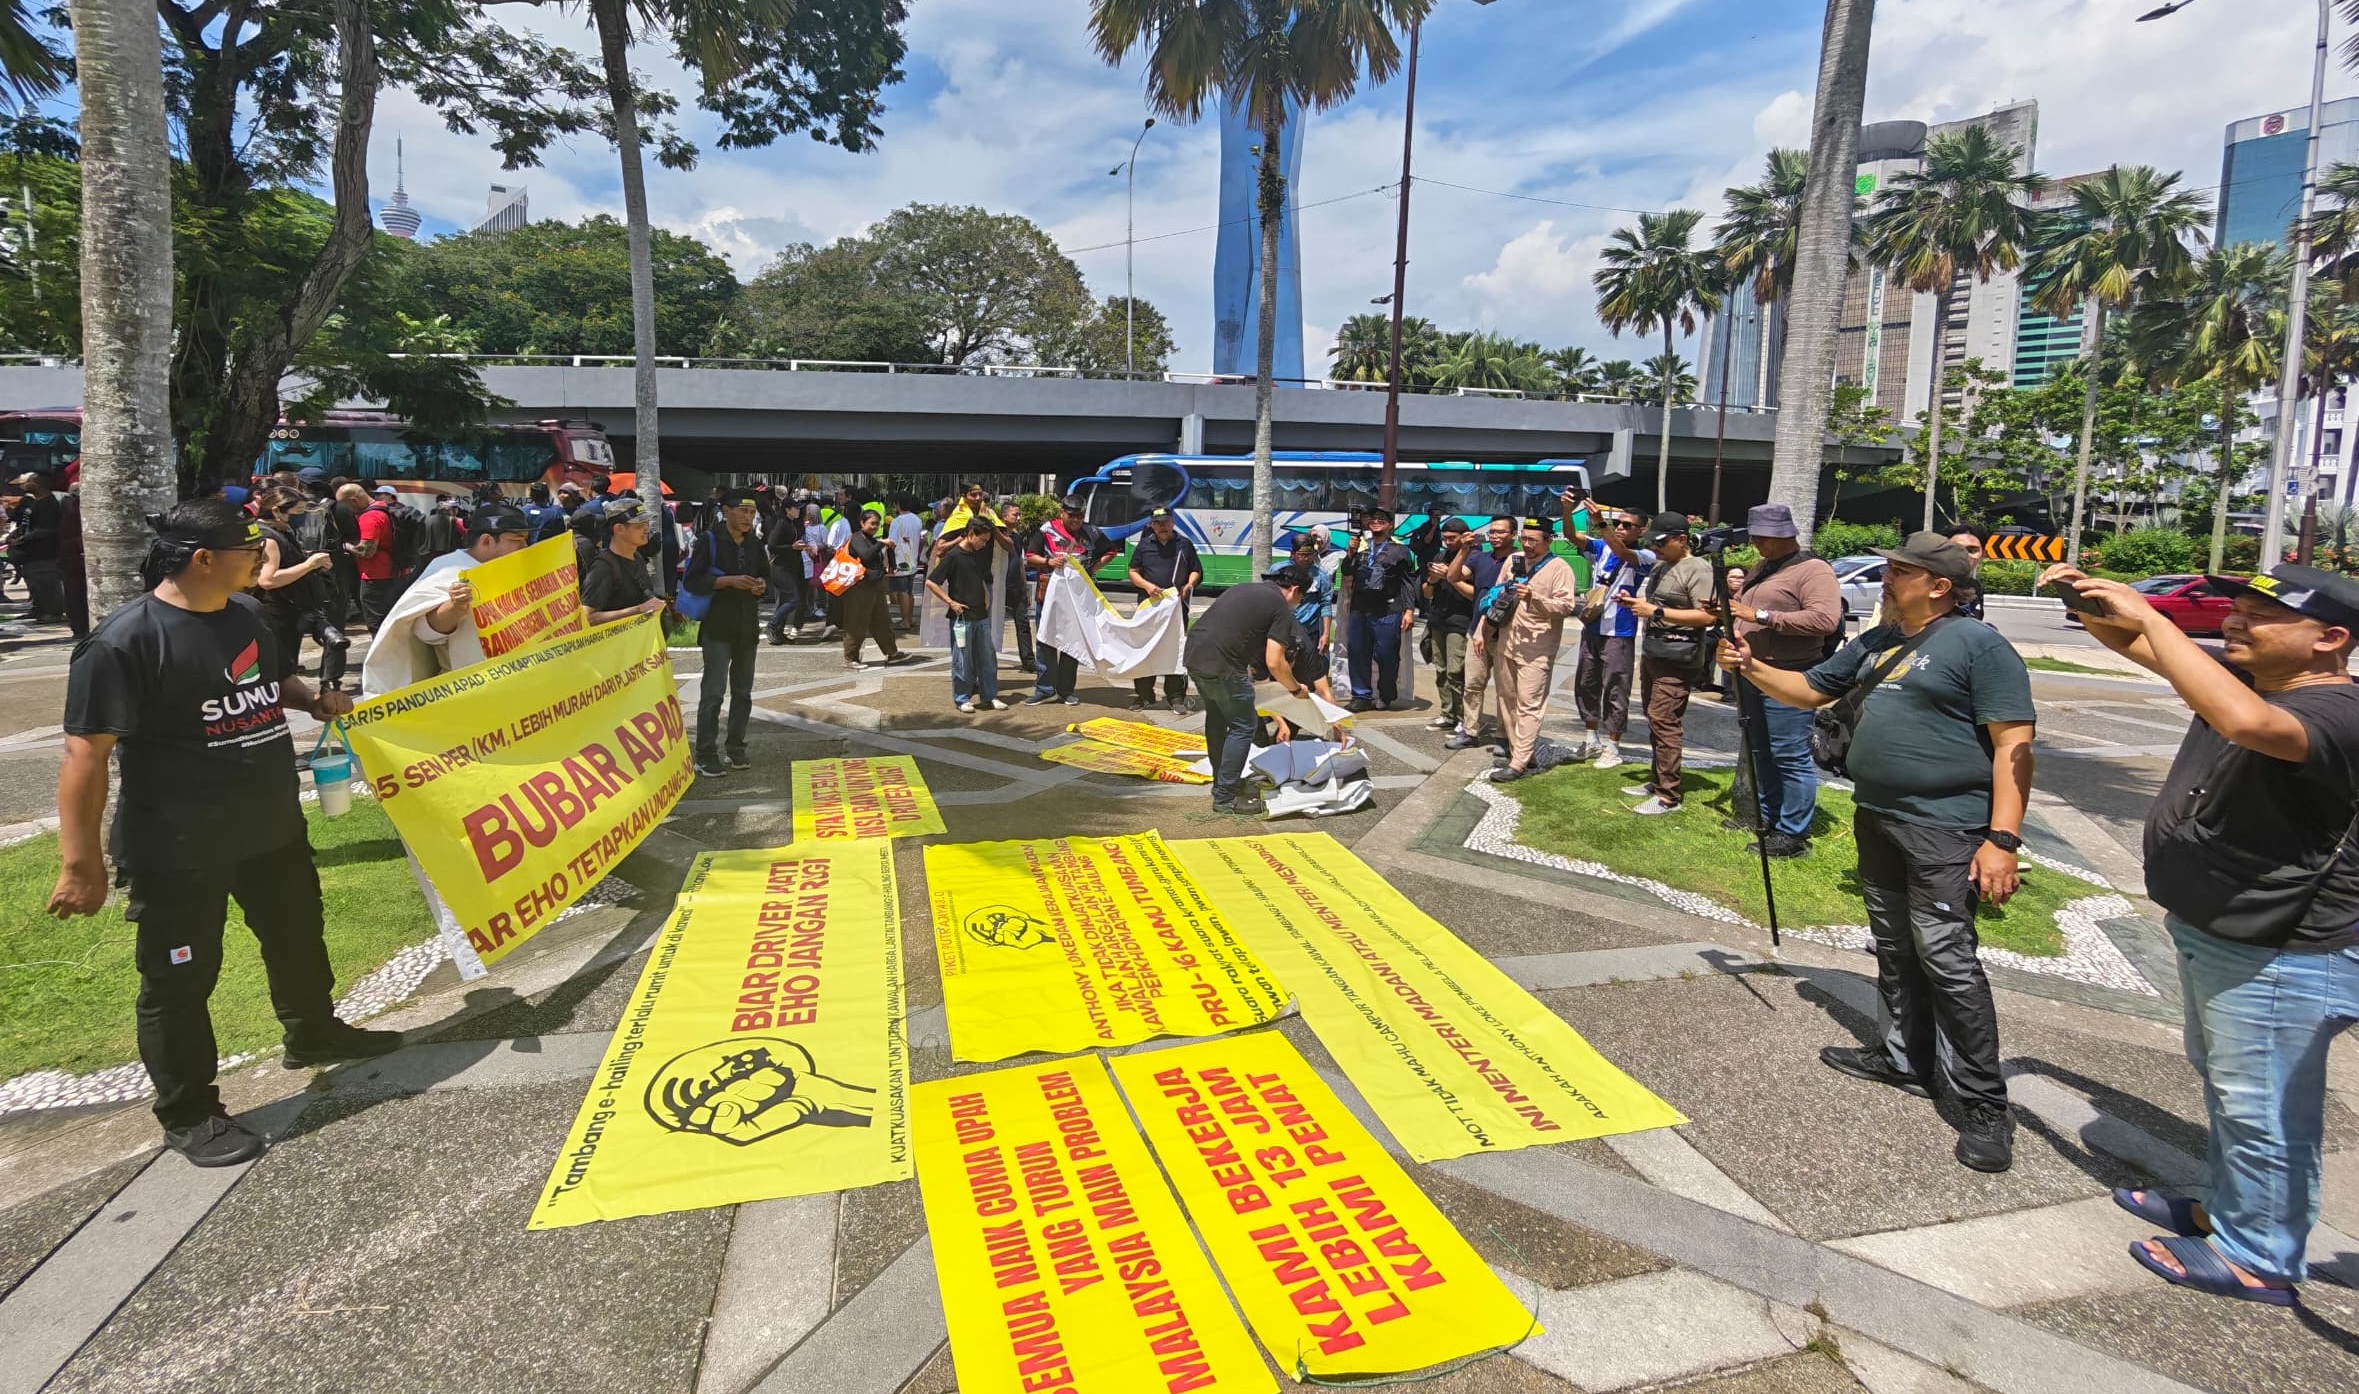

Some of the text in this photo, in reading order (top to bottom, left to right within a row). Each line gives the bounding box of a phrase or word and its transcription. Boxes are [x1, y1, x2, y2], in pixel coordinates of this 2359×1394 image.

[385, 686, 453, 717] PANDUAN
[489, 662, 512, 682] EHO
[510, 647, 553, 677] KAPITALIS
[403, 753, 444, 789] SEN
[510, 706, 554, 742] LEBIH
[551, 686, 596, 724] MURAH
[593, 673, 618, 702] DARI
[614, 659, 650, 692] PLASTIK
[462, 693, 684, 885] BUBAR APAD
[842, 760, 874, 791] UNTUNG
[884, 786, 922, 821] DRIVER
[514, 872, 569, 929] EHO
[566, 802, 651, 886] TETAPKAN
[1077, 856, 1113, 903] E-HAILING
[884, 898, 894, 926] TAMBANG
[1242, 880, 1275, 907] E-HAILING
[1291, 887, 1348, 930] MENTERI
[747, 901, 792, 969] DRIVER
[787, 894, 828, 969] JANGAN
[885, 927, 896, 949] LANTAI
[1045, 853, 1136, 1012] JIKA TIDAK DIKUATKUASAKAN
[1052, 918, 1072, 940] DAN
[1054, 840, 1168, 1033] KAWALAN HARGA LANTAI TAMBANG
[1142, 906, 1188, 951] KAMU
[1189, 920, 1214, 947] suara
[1209, 916, 1236, 946] lawan,
[1269, 908, 1303, 938] TAMBANG
[1375, 920, 1404, 940] SAHAM
[886, 950, 897, 974] HARGA
[1061, 941, 1085, 967] LOKE
[1208, 949, 1242, 984] rakyat
[1300, 940, 1330, 966] KAWAL
[1336, 932, 1382, 960] ATAU
[624, 1000, 656, 1039] terlalu
[644, 971, 668, 998] rumit
[658, 943, 679, 968] untuk
[731, 972, 780, 1032] BIAR
[777, 975, 820, 1027] EHO
[887, 976, 899, 1016] KAWALAN
[1074, 972, 1115, 1039] ANTHONY
[1322, 967, 1360, 1002] TANGAN
[1370, 963, 1443, 1020] MADANI
[1434, 971, 1478, 1005] PEMBELA
[1355, 1004, 1398, 1041] CAMPUR
[1472, 1006, 1504, 1026] LOKE
[888, 1018, 902, 1067] TUNTUTAN
[1392, 1043, 1430, 1076] MAHU
[1430, 1023, 1529, 1103] MENTERI
[1497, 1029, 1554, 1072] ANTHONY
[890, 1069, 906, 1163] KUATKUASAKAN
[1423, 1078, 1463, 1114] TIDAK
[1549, 1075, 1608, 1118] ADAKAH
[1456, 1116, 1495, 1146] MOT
[1514, 1106, 1560, 1131] INI
[1198, 1068, 1411, 1325] LEBIH 13 JAM
[1246, 1074, 1446, 1291] KAMI PENAT
[1015, 1141, 1104, 1295] YANG TURUN
[1038, 1072, 1216, 1393] MALAYSIA MAIN PROBLEM
[1154, 1068, 1366, 1356] KAMI BEKERJA
[949, 1093, 1079, 1394] EMUA NAIK CUMA UPAH
